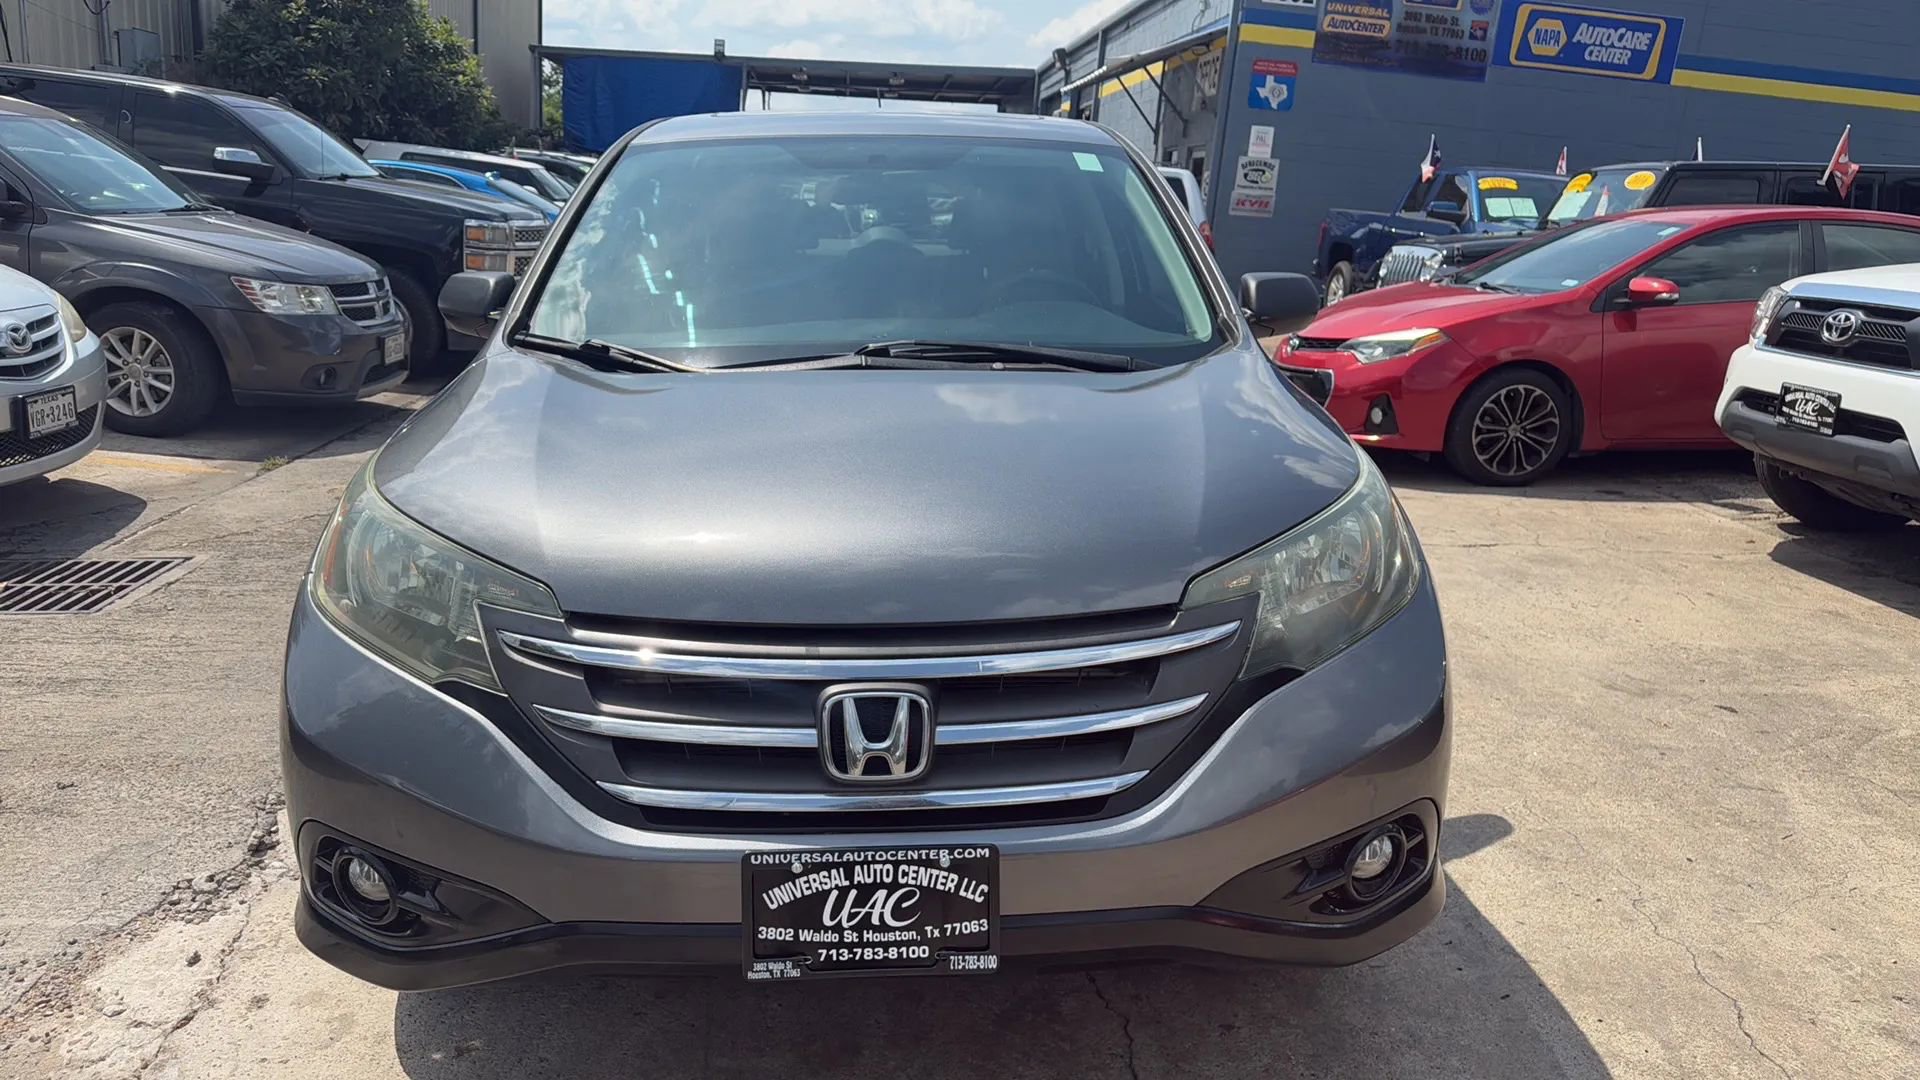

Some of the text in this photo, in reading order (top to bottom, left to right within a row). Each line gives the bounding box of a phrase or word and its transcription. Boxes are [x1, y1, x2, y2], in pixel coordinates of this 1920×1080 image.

[1326, 2, 1390, 18] UNIVERSAL
[1327, 16, 1385, 35] AUTOCENTER
[1533, 27, 1562, 47] NAPA
[1572, 22, 1653, 51] AUTOCARE
[1583, 45, 1632, 65] CENTER
[40, 393, 60, 405] TEXAS
[1795, 398, 1820, 416] UAC
[750, 848, 990, 865] UNIVERSALAUTOCENTER.COM
[762, 863, 989, 910] UNIVERSAL AUTO CENTER LLC
[822, 887, 922, 929] UAC
[757, 919, 989, 943] 3802 Waldo St Houston, Tx 77063
[818, 945, 930, 962] 713-783-8100
[949, 955, 998, 970] 713-783-8100
[773, 969, 781, 978] TX
